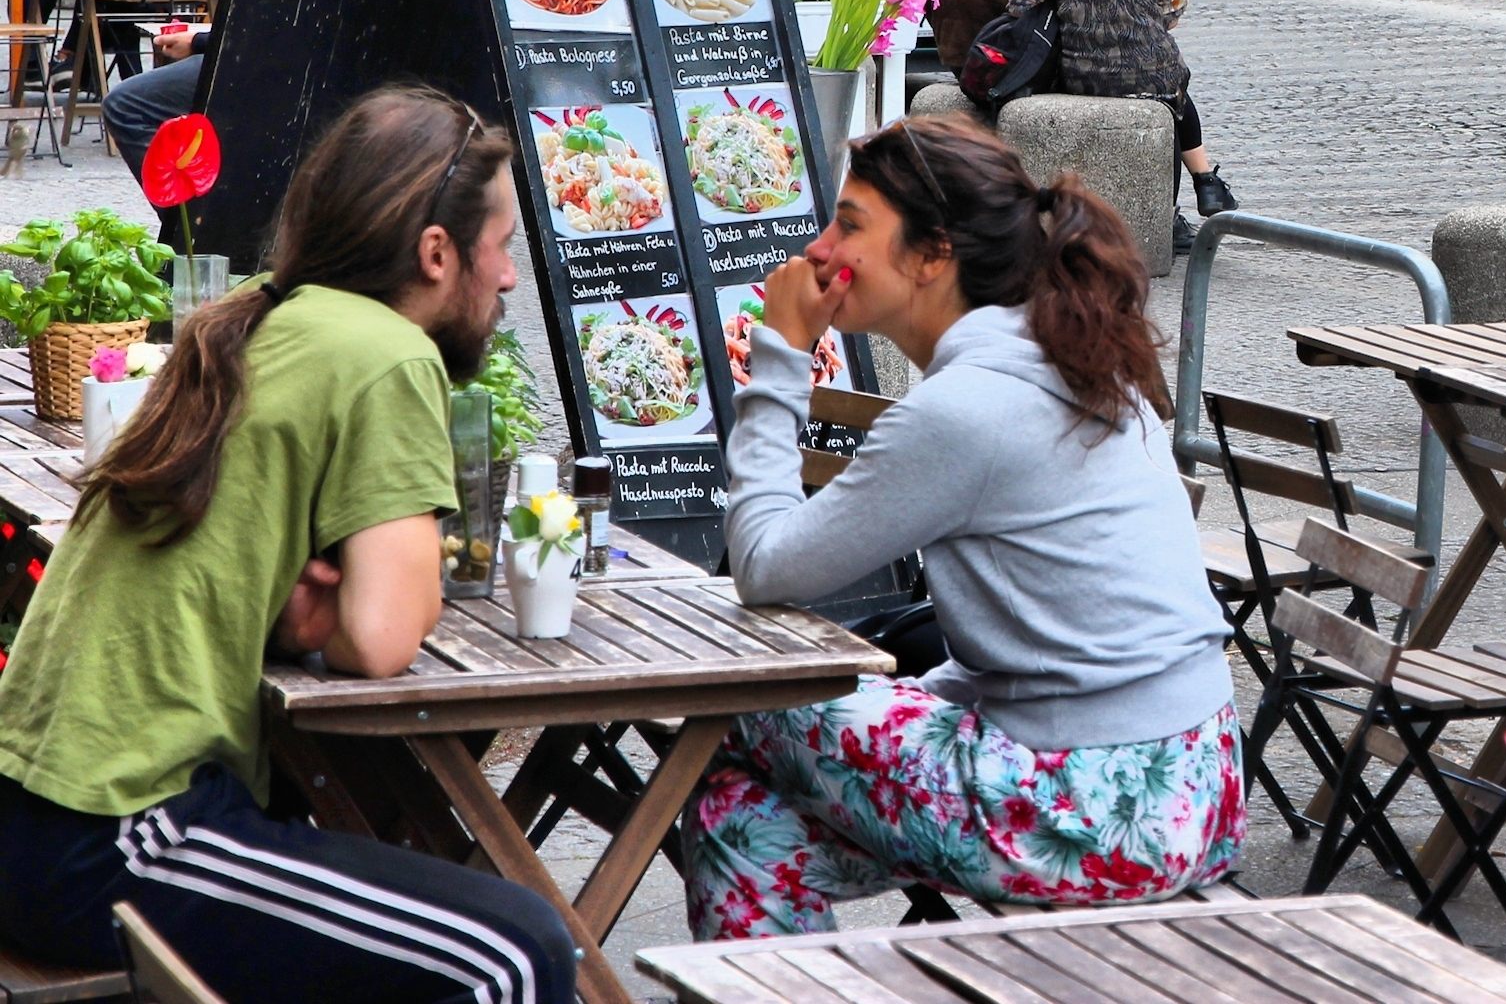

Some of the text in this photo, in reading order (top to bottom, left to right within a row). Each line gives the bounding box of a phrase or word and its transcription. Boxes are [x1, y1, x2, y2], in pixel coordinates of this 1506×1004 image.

[669, 25, 769, 46] Pasta mit Birne
[528, 48, 557, 65] Pasta
[559, 47, 617, 71] Bolognese
[674, 46, 763, 65] und Walnuß in
[677, 65, 770, 87] Gorgonzolasoße
[611, 80, 636, 96] 5,50
[715, 225, 743, 244] Pasta
[747, 223, 767, 239] mit
[772, 218, 819, 237] Ruccola-
[565, 242, 592, 259] Pasta
[593, 241, 610, 255] mit
[645, 235, 665, 250] Feta
[568, 260, 657, 279] Hähnchen in einer
[572, 271, 679, 301] Sahnesoße 5,50
[616, 454, 649, 477] Pasta
[651, 456, 668, 474] mit
[670, 455, 715, 473] Ruccola-
[620, 482, 705, 505] Haselnusspesto
[569, 557, 582, 582] 4
